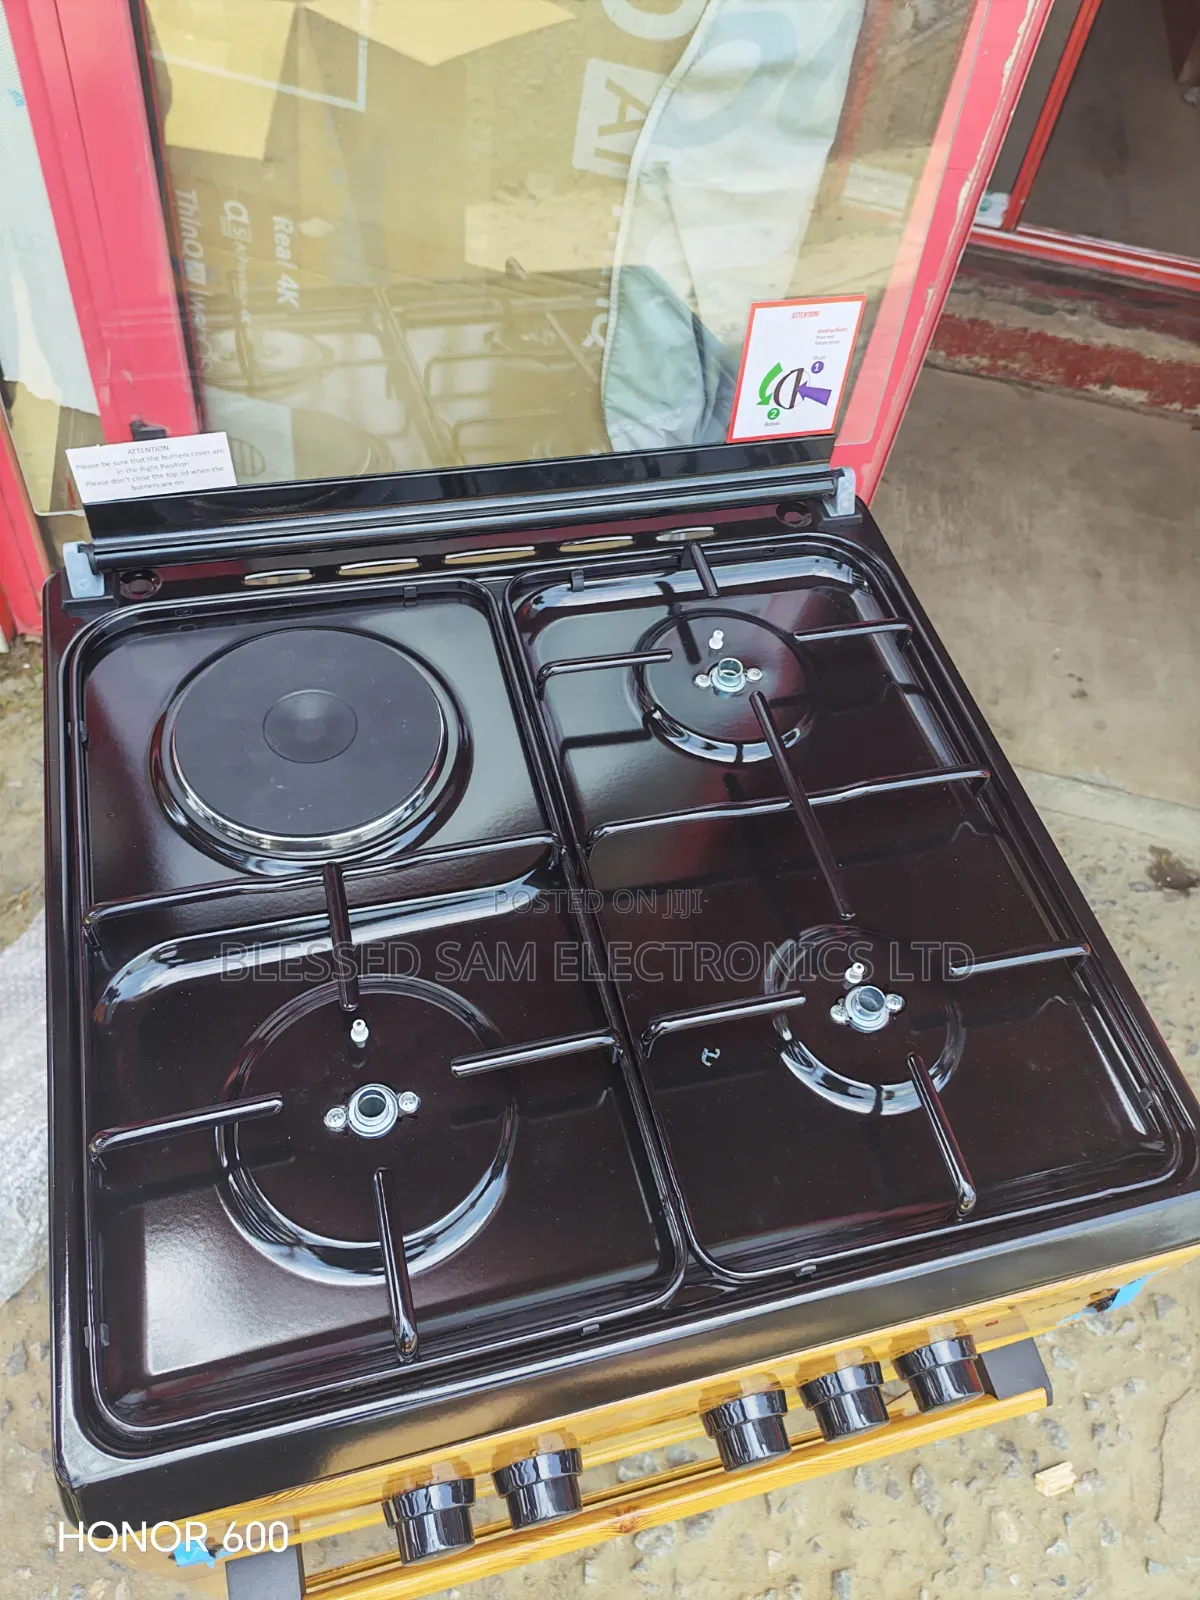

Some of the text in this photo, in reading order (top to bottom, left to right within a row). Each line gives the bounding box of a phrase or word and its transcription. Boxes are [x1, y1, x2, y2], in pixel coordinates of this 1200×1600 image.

[175, 188, 205, 258] ThinQ
[272, 215, 299, 309] Real 4K
[128, 445, 170, 456] ATTENTION
[76, 462, 100, 471] Please
[161, 452, 190, 460] burners
[139, 464, 159, 473] Right
[160, 461, 189, 469] Position
[111, 476, 131, 484] don't
[132, 474, 151, 482] close
[165, 471, 179, 479] top
[131, 482, 160, 491] burners
